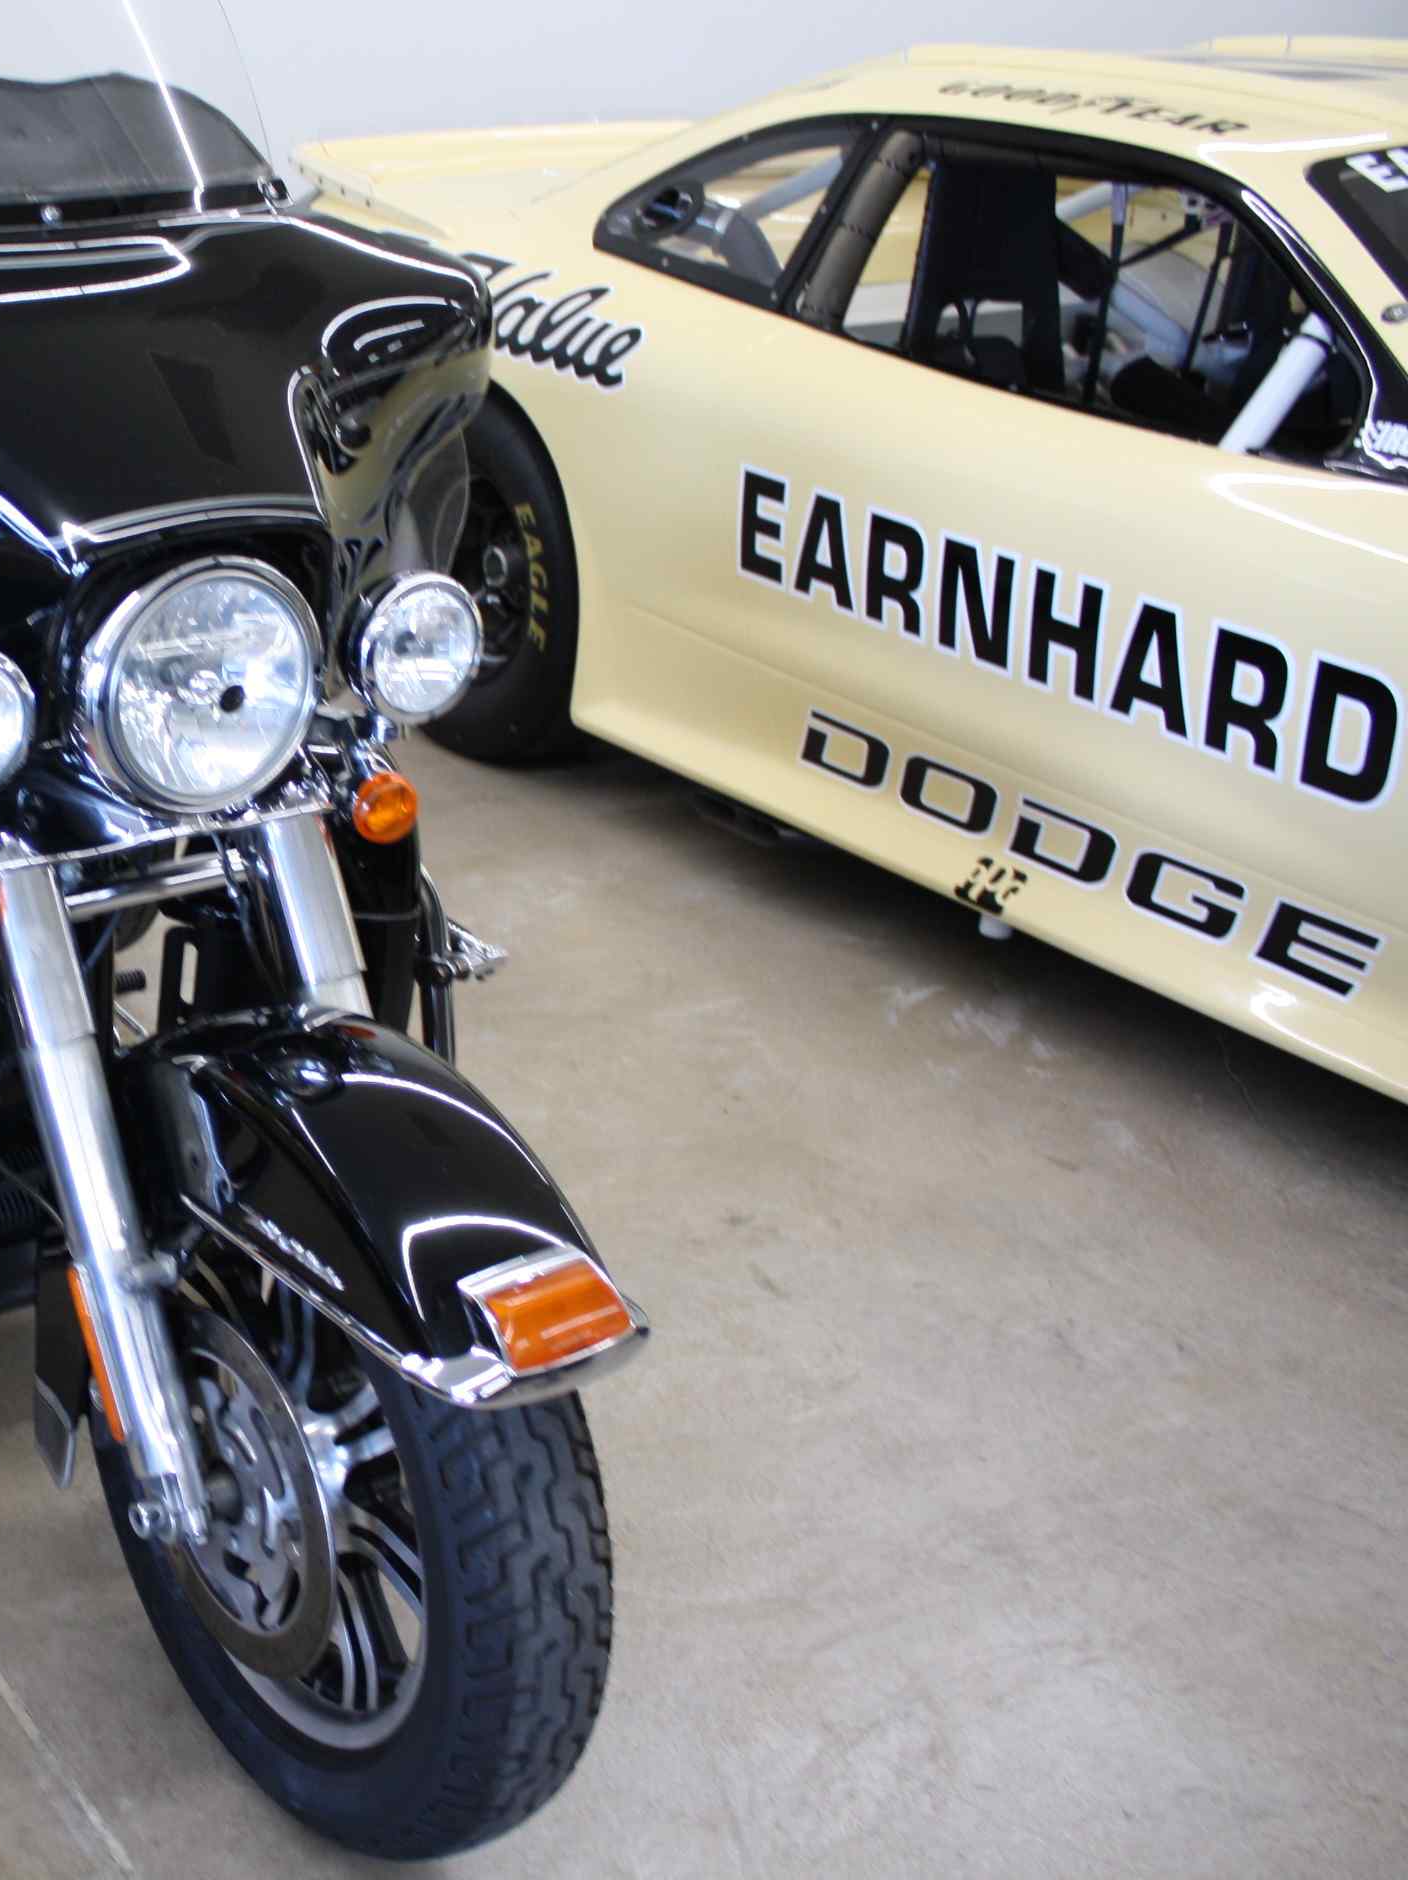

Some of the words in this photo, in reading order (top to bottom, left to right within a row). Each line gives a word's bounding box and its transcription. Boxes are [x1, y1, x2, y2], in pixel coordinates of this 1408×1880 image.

[515, 503, 549, 652] EAGLE
[738, 463, 1404, 812] EARNHARD
[798, 708, 1382, 998] DODGE
